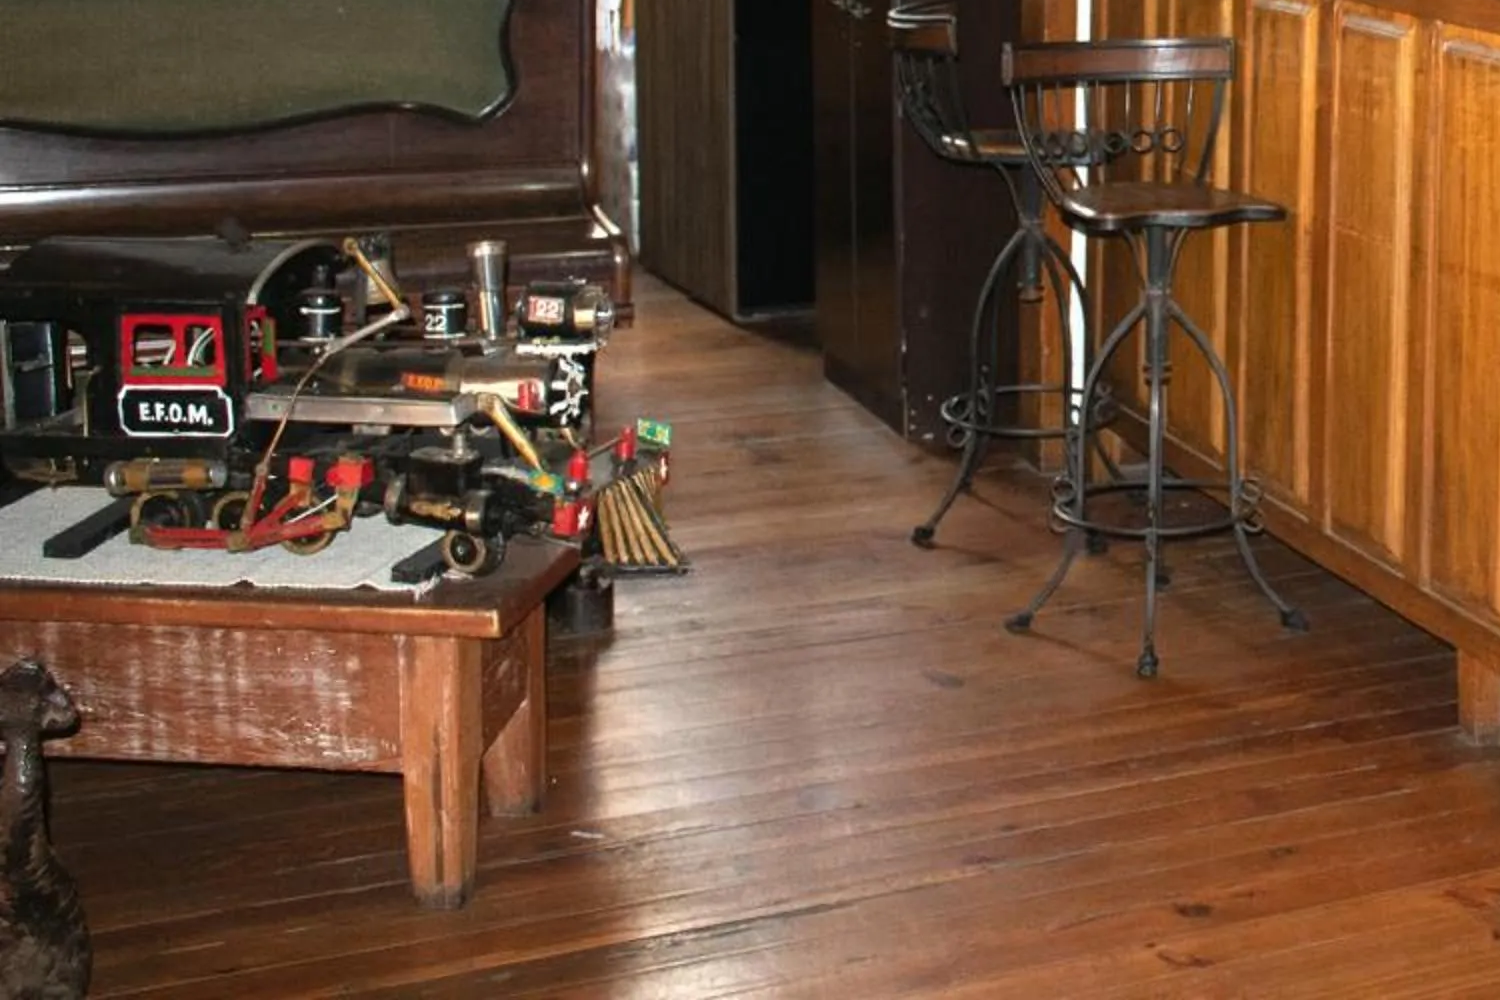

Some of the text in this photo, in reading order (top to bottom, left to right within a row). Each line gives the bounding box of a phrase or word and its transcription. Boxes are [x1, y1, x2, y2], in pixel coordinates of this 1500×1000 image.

[537, 301, 559, 318] 22
[425, 314, 446, 332] 22
[138, 402, 214, 426] E.F.O.M.
